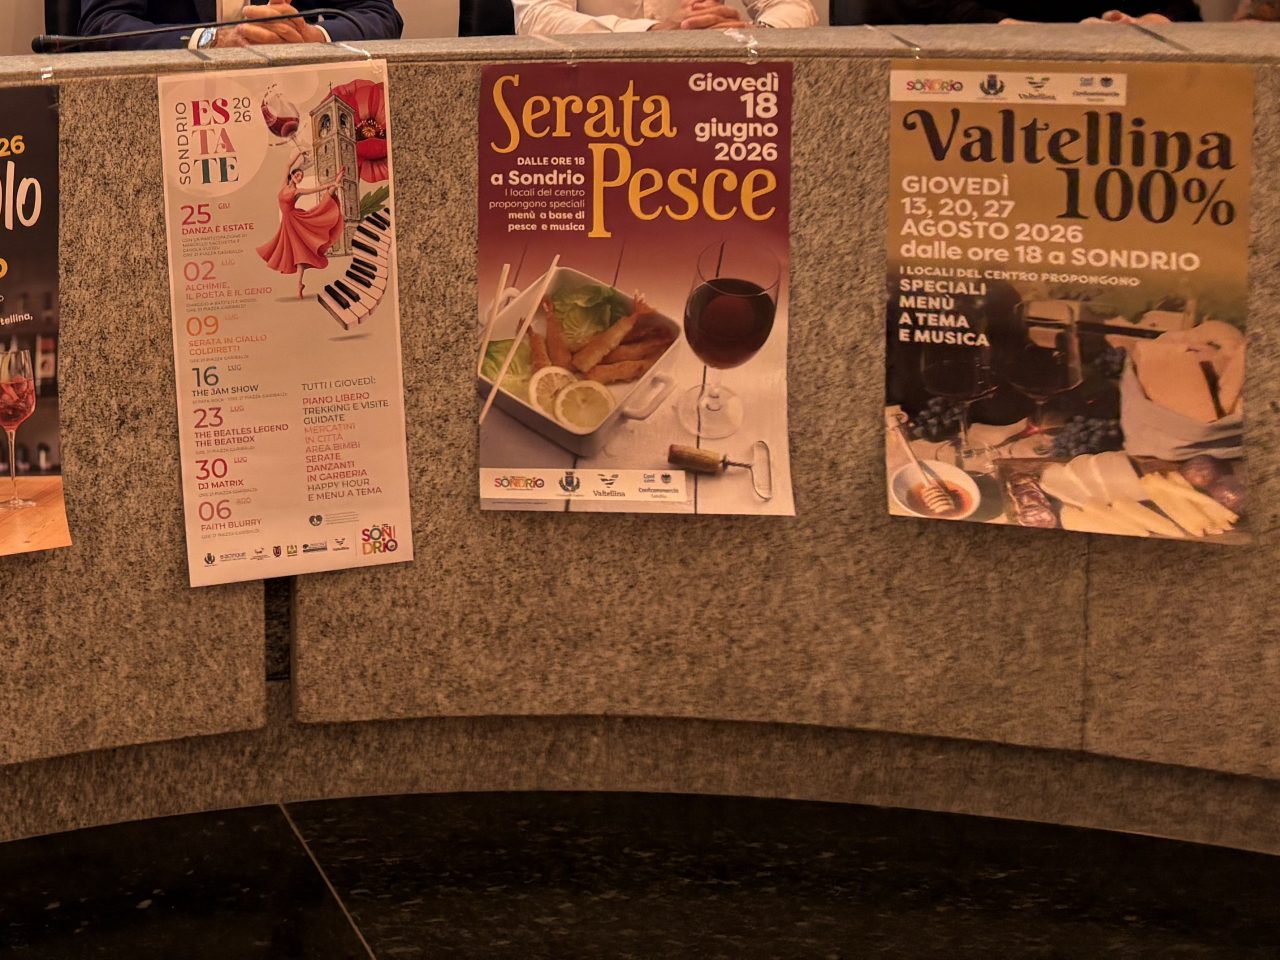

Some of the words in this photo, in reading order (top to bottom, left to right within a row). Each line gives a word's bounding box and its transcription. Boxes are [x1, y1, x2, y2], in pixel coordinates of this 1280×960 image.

[689, 73, 779, 92] Giovedì
[192, 97, 230, 126] ES
[233, 97, 251, 109] 20
[740, 93, 778, 118] 18
[234, 111, 251, 122] 26
[491, 74, 677, 153] Serata
[694, 118, 778, 142] giugno
[175, 102, 190, 184] SONDRIO
[192, 128, 235, 155] TA
[903, 108, 1236, 173] Valtellina
[714, 143, 778, 161] 2026
[194, 157, 239, 184] TE
[491, 173, 504, 185] a
[508, 170, 585, 185] Sondrio
[510, 188, 534, 196] locali
[537, 188, 552, 196] del
[588, 143, 777, 237] Pesce
[902, 174, 1009, 196] GIOVEDÌ
[489, 200, 547, 209] propongono
[549, 200, 585, 209] speciali
[1056, 167, 1235, 225] 100%
[181, 204, 211, 225] 25
[508, 211, 535, 219] menù
[549, 211, 572, 219] base
[574, 211, 584, 219] di
[901, 198, 933, 218] 13,
[938, 198, 977, 221] 20,
[983, 200, 1015, 217] 27
[182, 226, 213, 235] DANZA
[223, 223, 254, 231] ESTATE
[508, 223, 537, 232] pesce
[901, 218, 1009, 240] AGOSTO
[1015, 223, 1083, 243] 2026
[900, 241, 962, 260] dalle
[968, 246, 1010, 262] ore
[1015, 245, 1042, 263] 18
[1048, 250, 1065, 265] a
[1071, 248, 1200, 272] SONDRIO
[183, 261, 215, 281] 02
[906, 267, 954, 278] LOCALI
[957, 269, 982, 279] DEL
[985, 270, 1038, 282] CENTRO
[1041, 273, 1140, 287] PROPONGONO
[899, 280, 986, 295] SPECIALI
[899, 293, 954, 310] MENÙ
[186, 315, 219, 336] 09
[899, 313, 912, 325] A
[916, 313, 969, 328] TEMA
[899, 330, 911, 342] E
[914, 330, 990, 347] MUSICA
[192, 366, 219, 387] 16
[192, 389, 208, 397] THE
[211, 388, 229, 396] JAM
[231, 385, 259, 393] SHOW
[303, 395, 333, 405] PIANO
[335, 392, 369, 402] LIBERO
[303, 404, 350, 415] TREKKING
[361, 400, 389, 409] VISITE
[193, 407, 223, 428] 23
[304, 414, 345, 424] GUIDATE
[195, 431, 211, 439] THE
[214, 428, 251, 437] BEATLES
[196, 440, 212, 448] THE
[214, 436, 255, 445] BEATBOX
[196, 458, 227, 480] 30
[211, 480, 244, 488] MATRIX
[308, 482, 340, 492] HAPPY
[342, 479, 370, 487] HOUR
[199, 500, 231, 521] 06
[201, 523, 226, 531] FAITH
[228, 519, 262, 529] BLURRY
